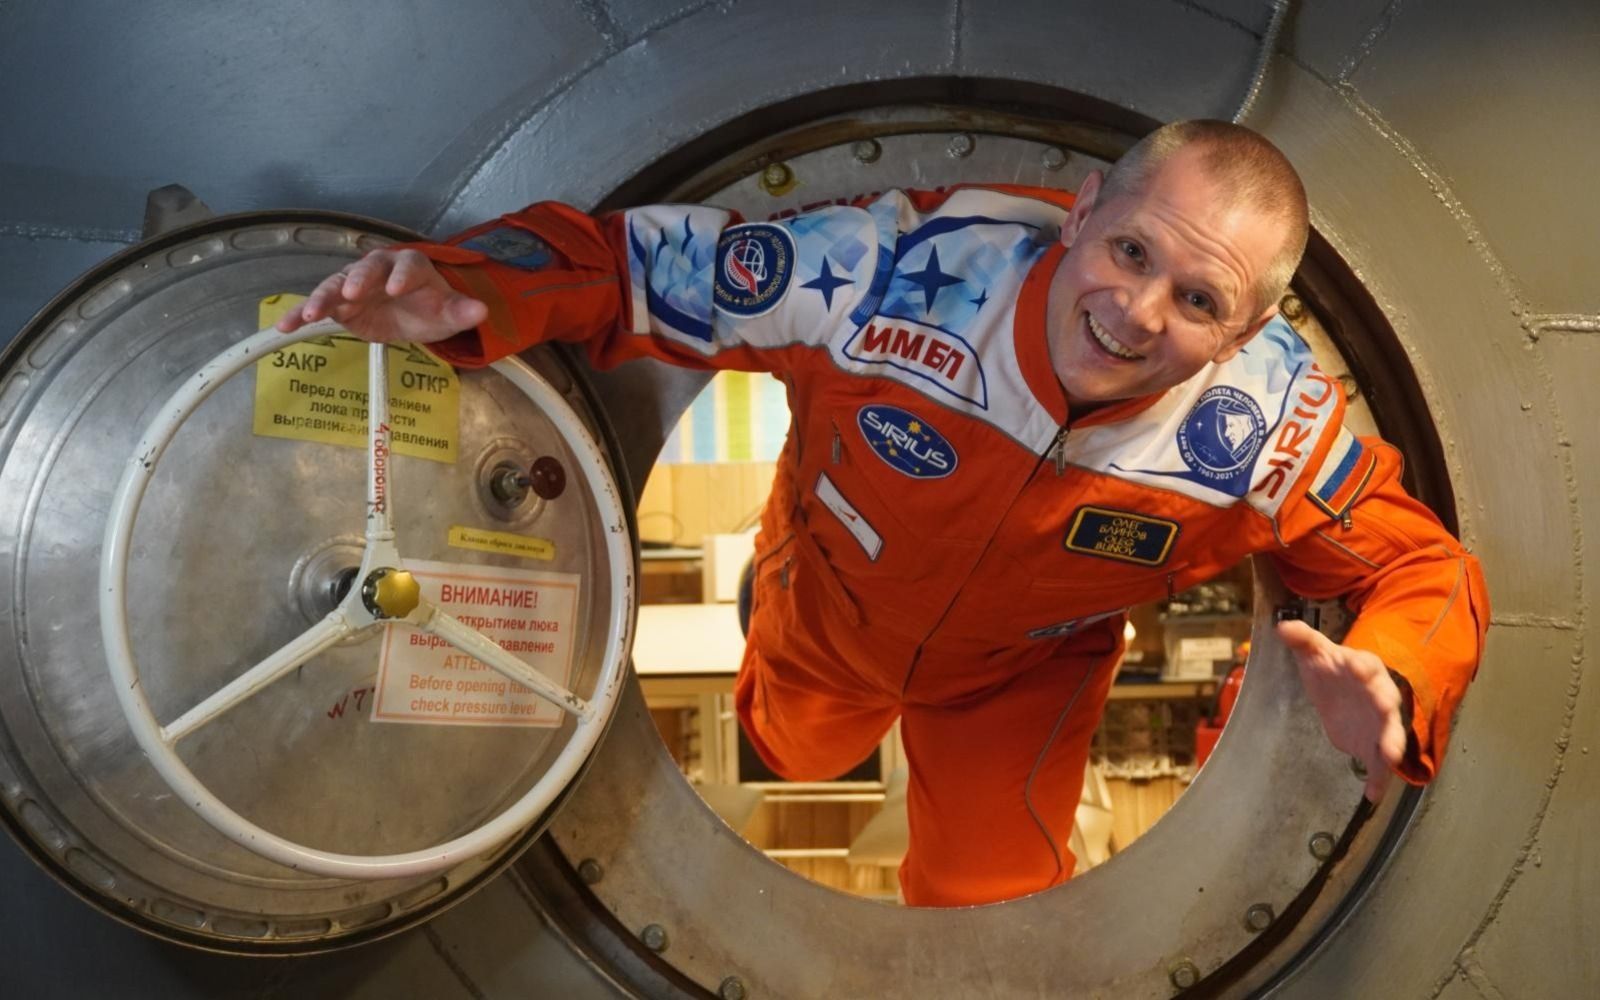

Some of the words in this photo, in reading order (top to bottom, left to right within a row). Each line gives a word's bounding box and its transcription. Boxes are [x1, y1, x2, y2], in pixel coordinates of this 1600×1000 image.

[271, 350, 328, 373] ЗАКР
[862, 323, 966, 381] ИМБП
[289, 378, 335, 399] Перед
[400, 370, 450, 395] ОТКР
[309, 400, 348, 417] люка
[374, 422, 390, 434] 4
[1252, 363, 1335, 500] SIRIU
[862, 410, 949, 470] SIRIUS
[440, 583, 539, 609] ВНИМАНИЕ!
[528, 619, 559, 632] люка
[409, 674, 453, 690] Before
[456, 679, 506, 697] opening
[410, 698, 450, 713] check
[453, 701, 508, 716] pressure
[509, 698, 538, 715] level
